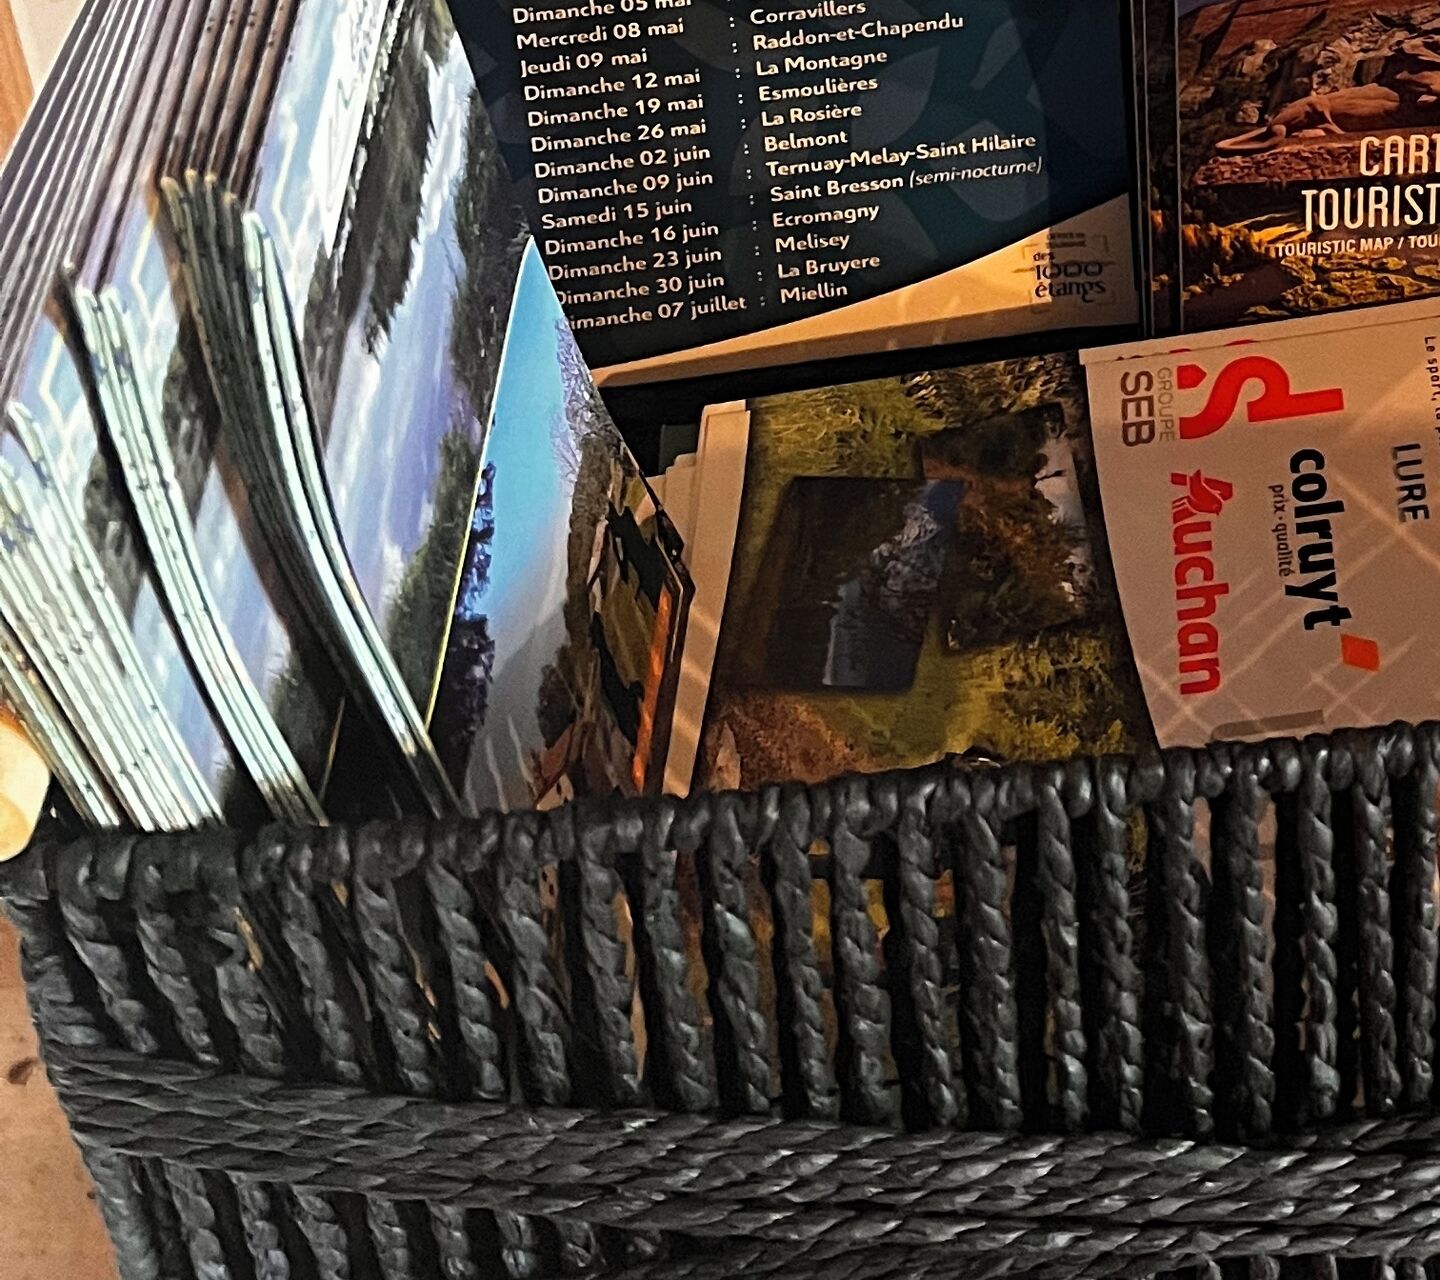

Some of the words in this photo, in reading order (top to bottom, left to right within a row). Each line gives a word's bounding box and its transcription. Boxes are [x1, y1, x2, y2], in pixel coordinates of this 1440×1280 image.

[517, 23, 607, 49] Mercredi
[613, 22, 640, 39] 08
[648, 18, 684, 36] mai
[750, 0, 867, 24] Corravillers
[538, 180, 637, 204] Dimanche
[643, 174, 669, 191] 09
[676, 172, 713, 193] juin
[765, 142, 966, 177] Ternuay-Melay-Saint
[972, 133, 1036, 153] Hilaire
[542, 204, 616, 230] Samedi
[624, 202, 649, 219] 15
[655, 200, 692, 221] juin
[770, 186, 821, 202] Saint
[828, 176, 903, 196] Bresson
[909, 156, 1042, 188] (semi-nocturne)
[656, 277, 681, 293] 30
[687, 274, 725, 295] juin
[777, 263, 799, 279] La
[806, 256, 880, 275] Bruyere
[1036, 261, 1104, 280] 1000
[1277, 239, 1356, 257] TOURISTIC
[1360, 237, 1393, 252] MAP
[569, 307, 652, 330] imanche
[658, 302, 683, 319] 07
[691, 296, 746, 320] juillet
[780, 284, 848, 304] Miellin
[1035, 280, 1106, 303] étangs
[1424, 335, 1437, 356] Le
[1121, 370, 1155, 447] SEB
[1156, 366, 1174, 442] GROUPE
[1391, 443, 1430, 523] LURE
[1285, 448, 1352, 631] colruyt
[1170, 469, 1233, 695] Auchan
